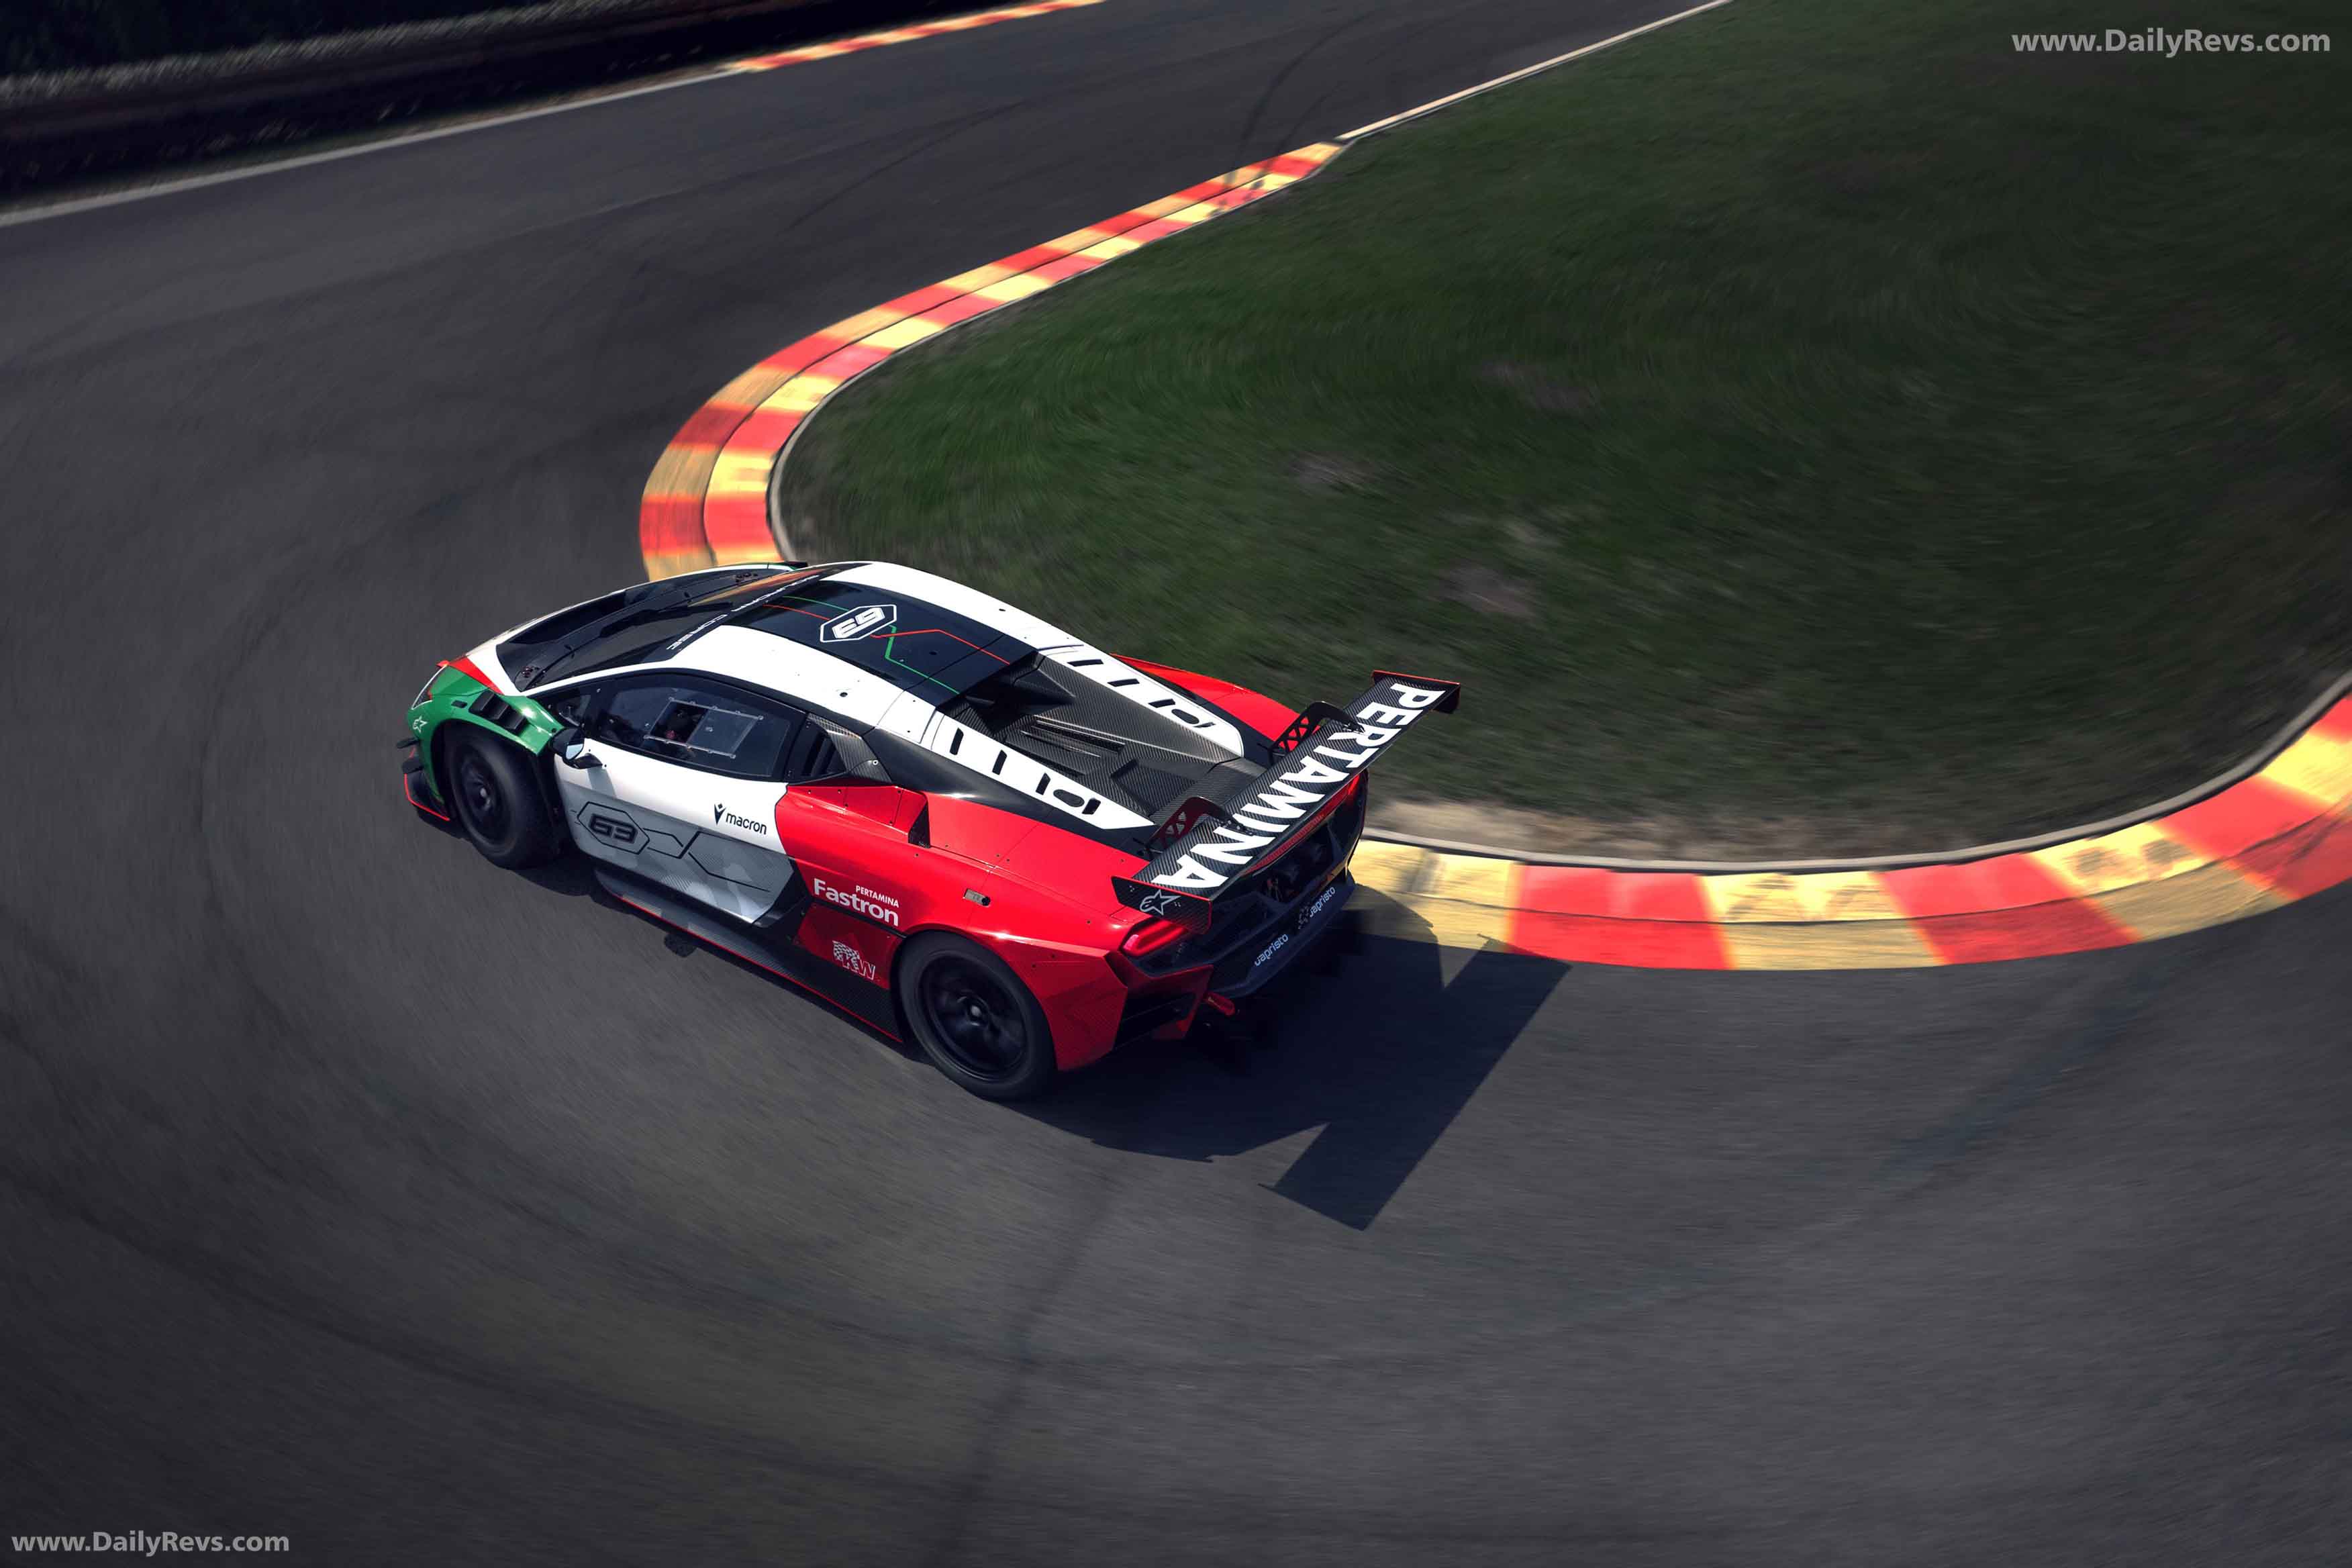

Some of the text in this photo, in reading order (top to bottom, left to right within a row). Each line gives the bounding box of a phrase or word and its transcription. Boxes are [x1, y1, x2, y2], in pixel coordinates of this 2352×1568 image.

[832, 607, 885, 639] 63
[1150, 683, 1446, 889] PERTAMINA
[589, 814, 638, 844] 63
[726, 813, 767, 835] macron
[814, 877, 899, 927] Fastron
[855, 885, 899, 908] PERTAMINA
